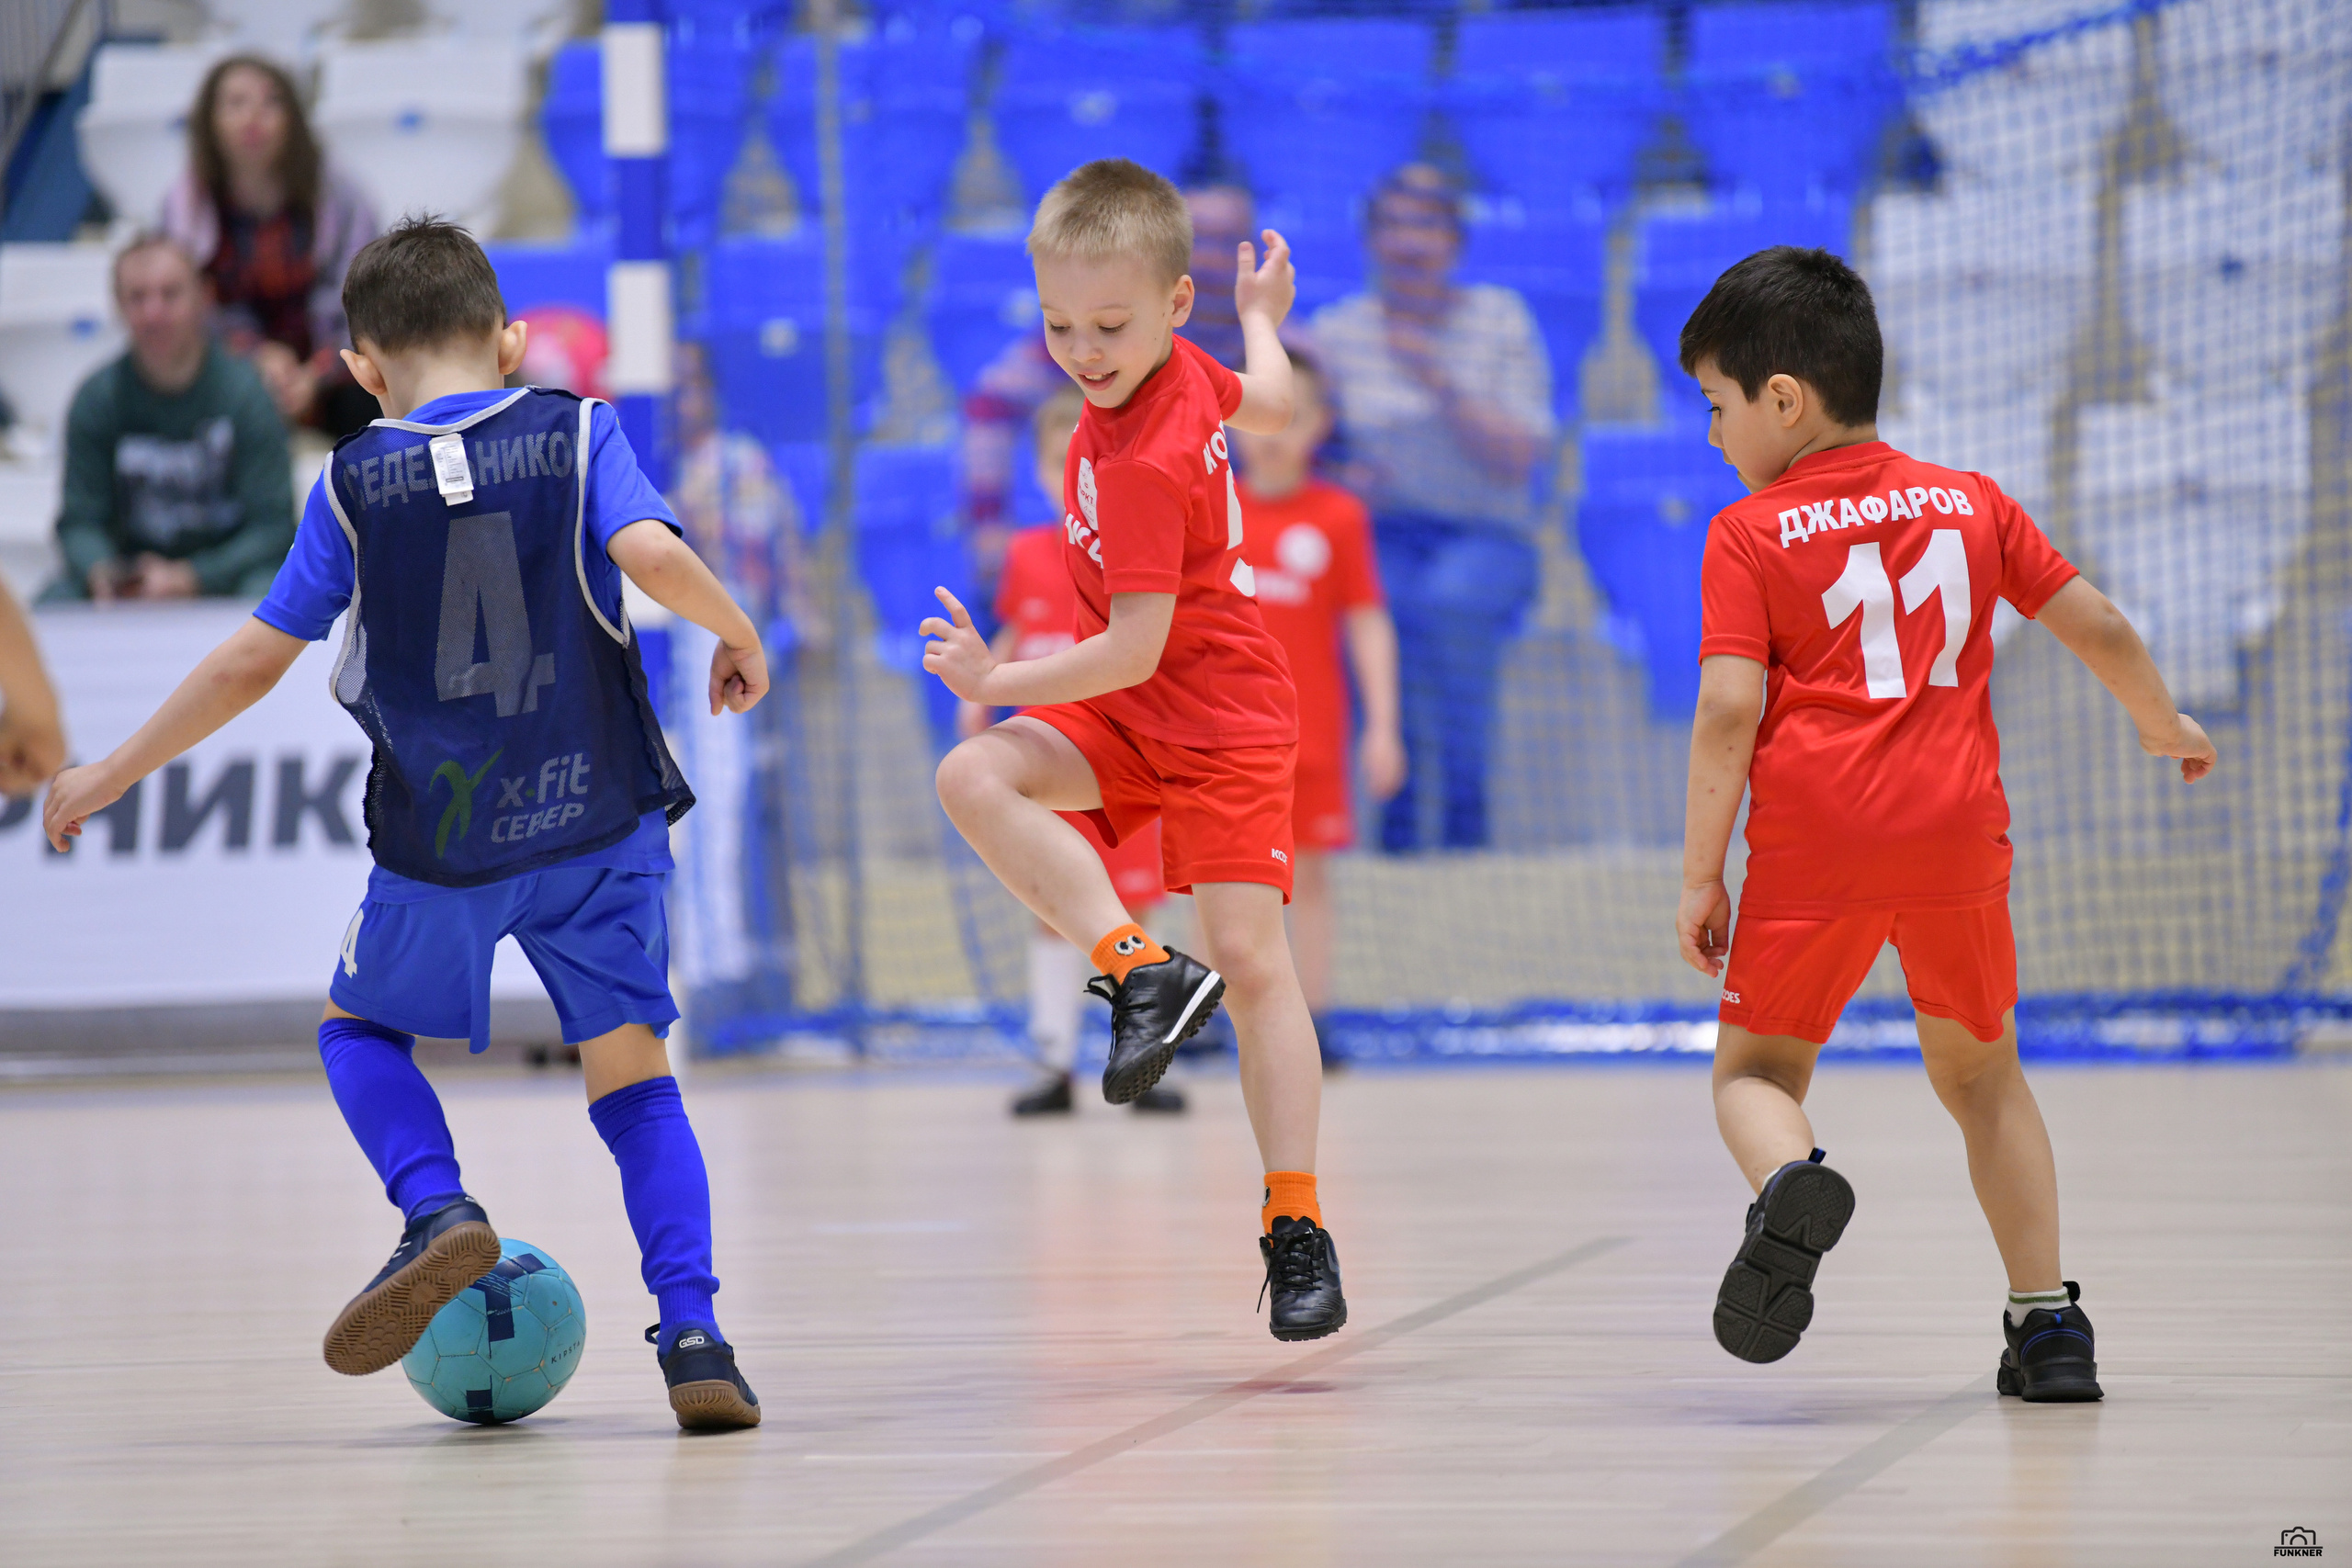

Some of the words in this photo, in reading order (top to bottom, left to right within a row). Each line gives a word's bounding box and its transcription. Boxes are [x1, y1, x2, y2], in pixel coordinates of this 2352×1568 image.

[1203, 418, 1229, 475] КО
[1778, 486, 1974, 548] ДЖАФАРОВ
[435, 511, 556, 717] 4
[1821, 529, 1972, 699] 11
[491, 803, 585, 843] СЕВЕР
[340, 907, 365, 979] 4
[550, 1340, 581, 1365] KIPSTA
[678, 1336, 706, 1349] GSD
